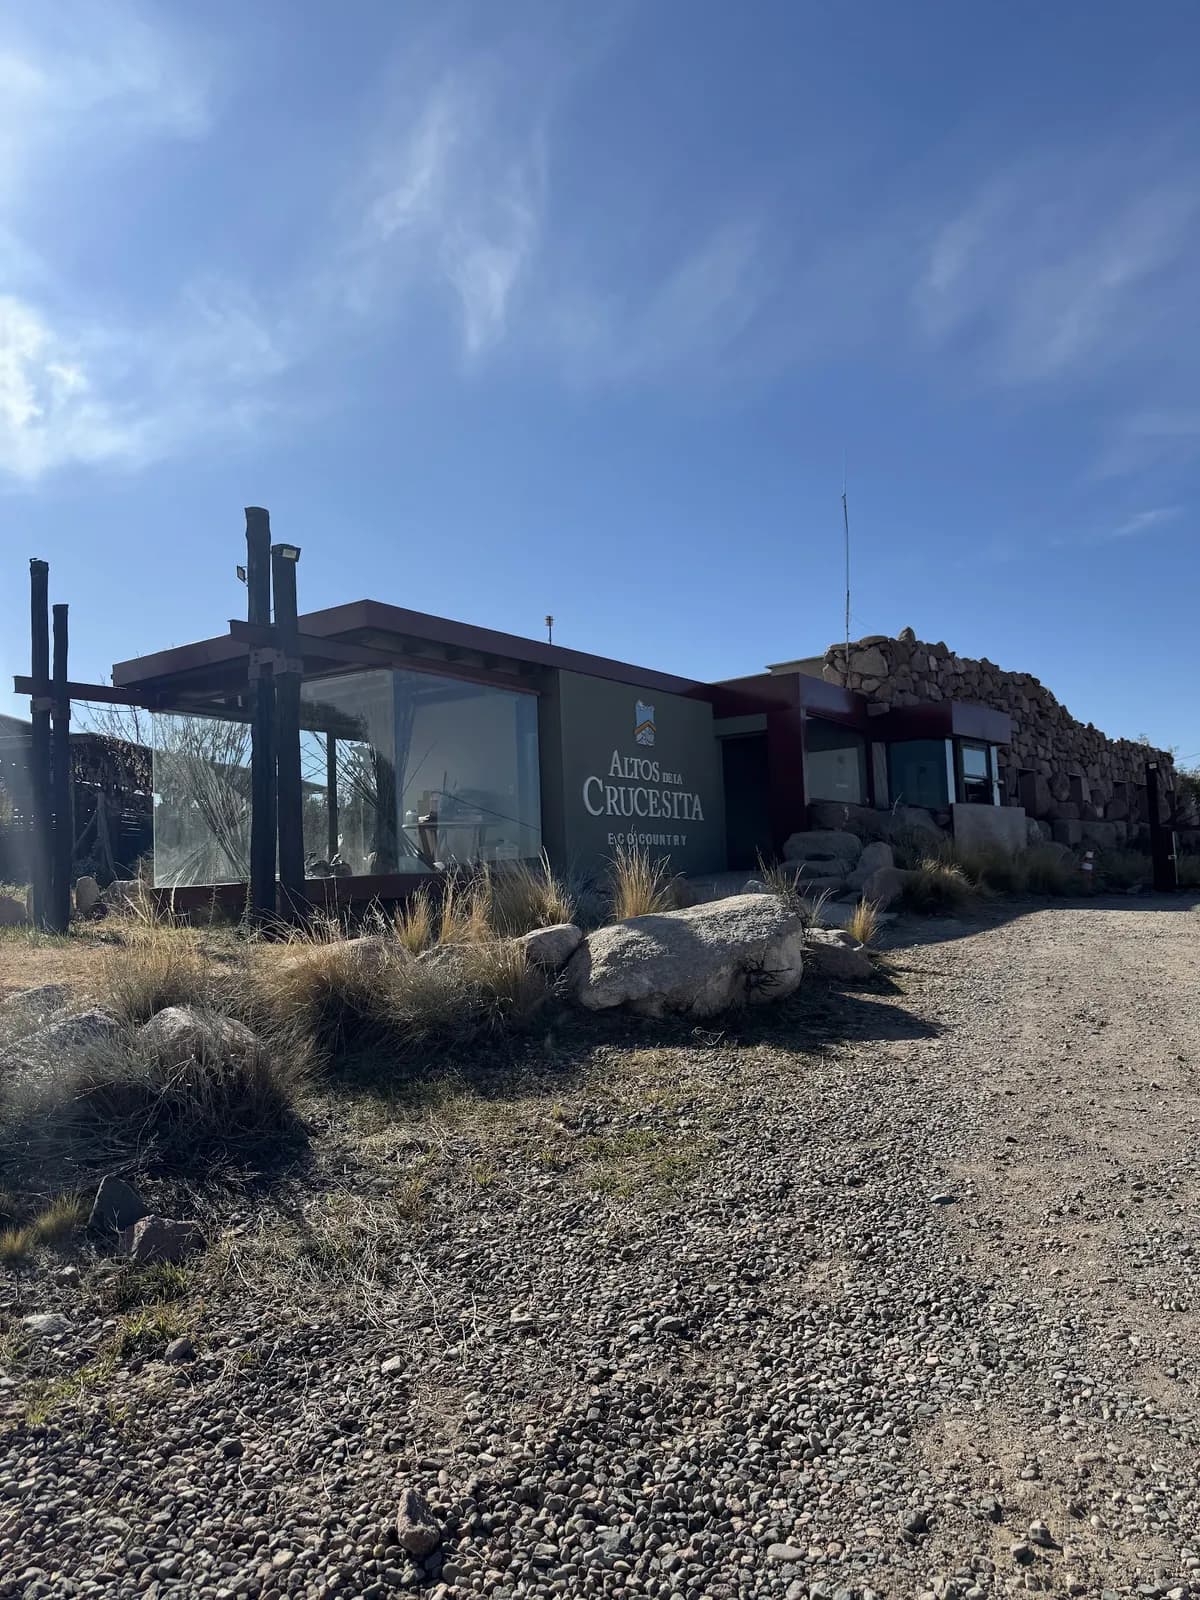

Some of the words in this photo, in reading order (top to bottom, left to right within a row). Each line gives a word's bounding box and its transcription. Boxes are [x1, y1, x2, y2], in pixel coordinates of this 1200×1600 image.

[608, 749, 660, 783] ALTOS
[583, 775, 704, 820] CRUCESITA
[607, 832, 634, 845] ECO
[638, 833, 687, 846] COUNTRY
